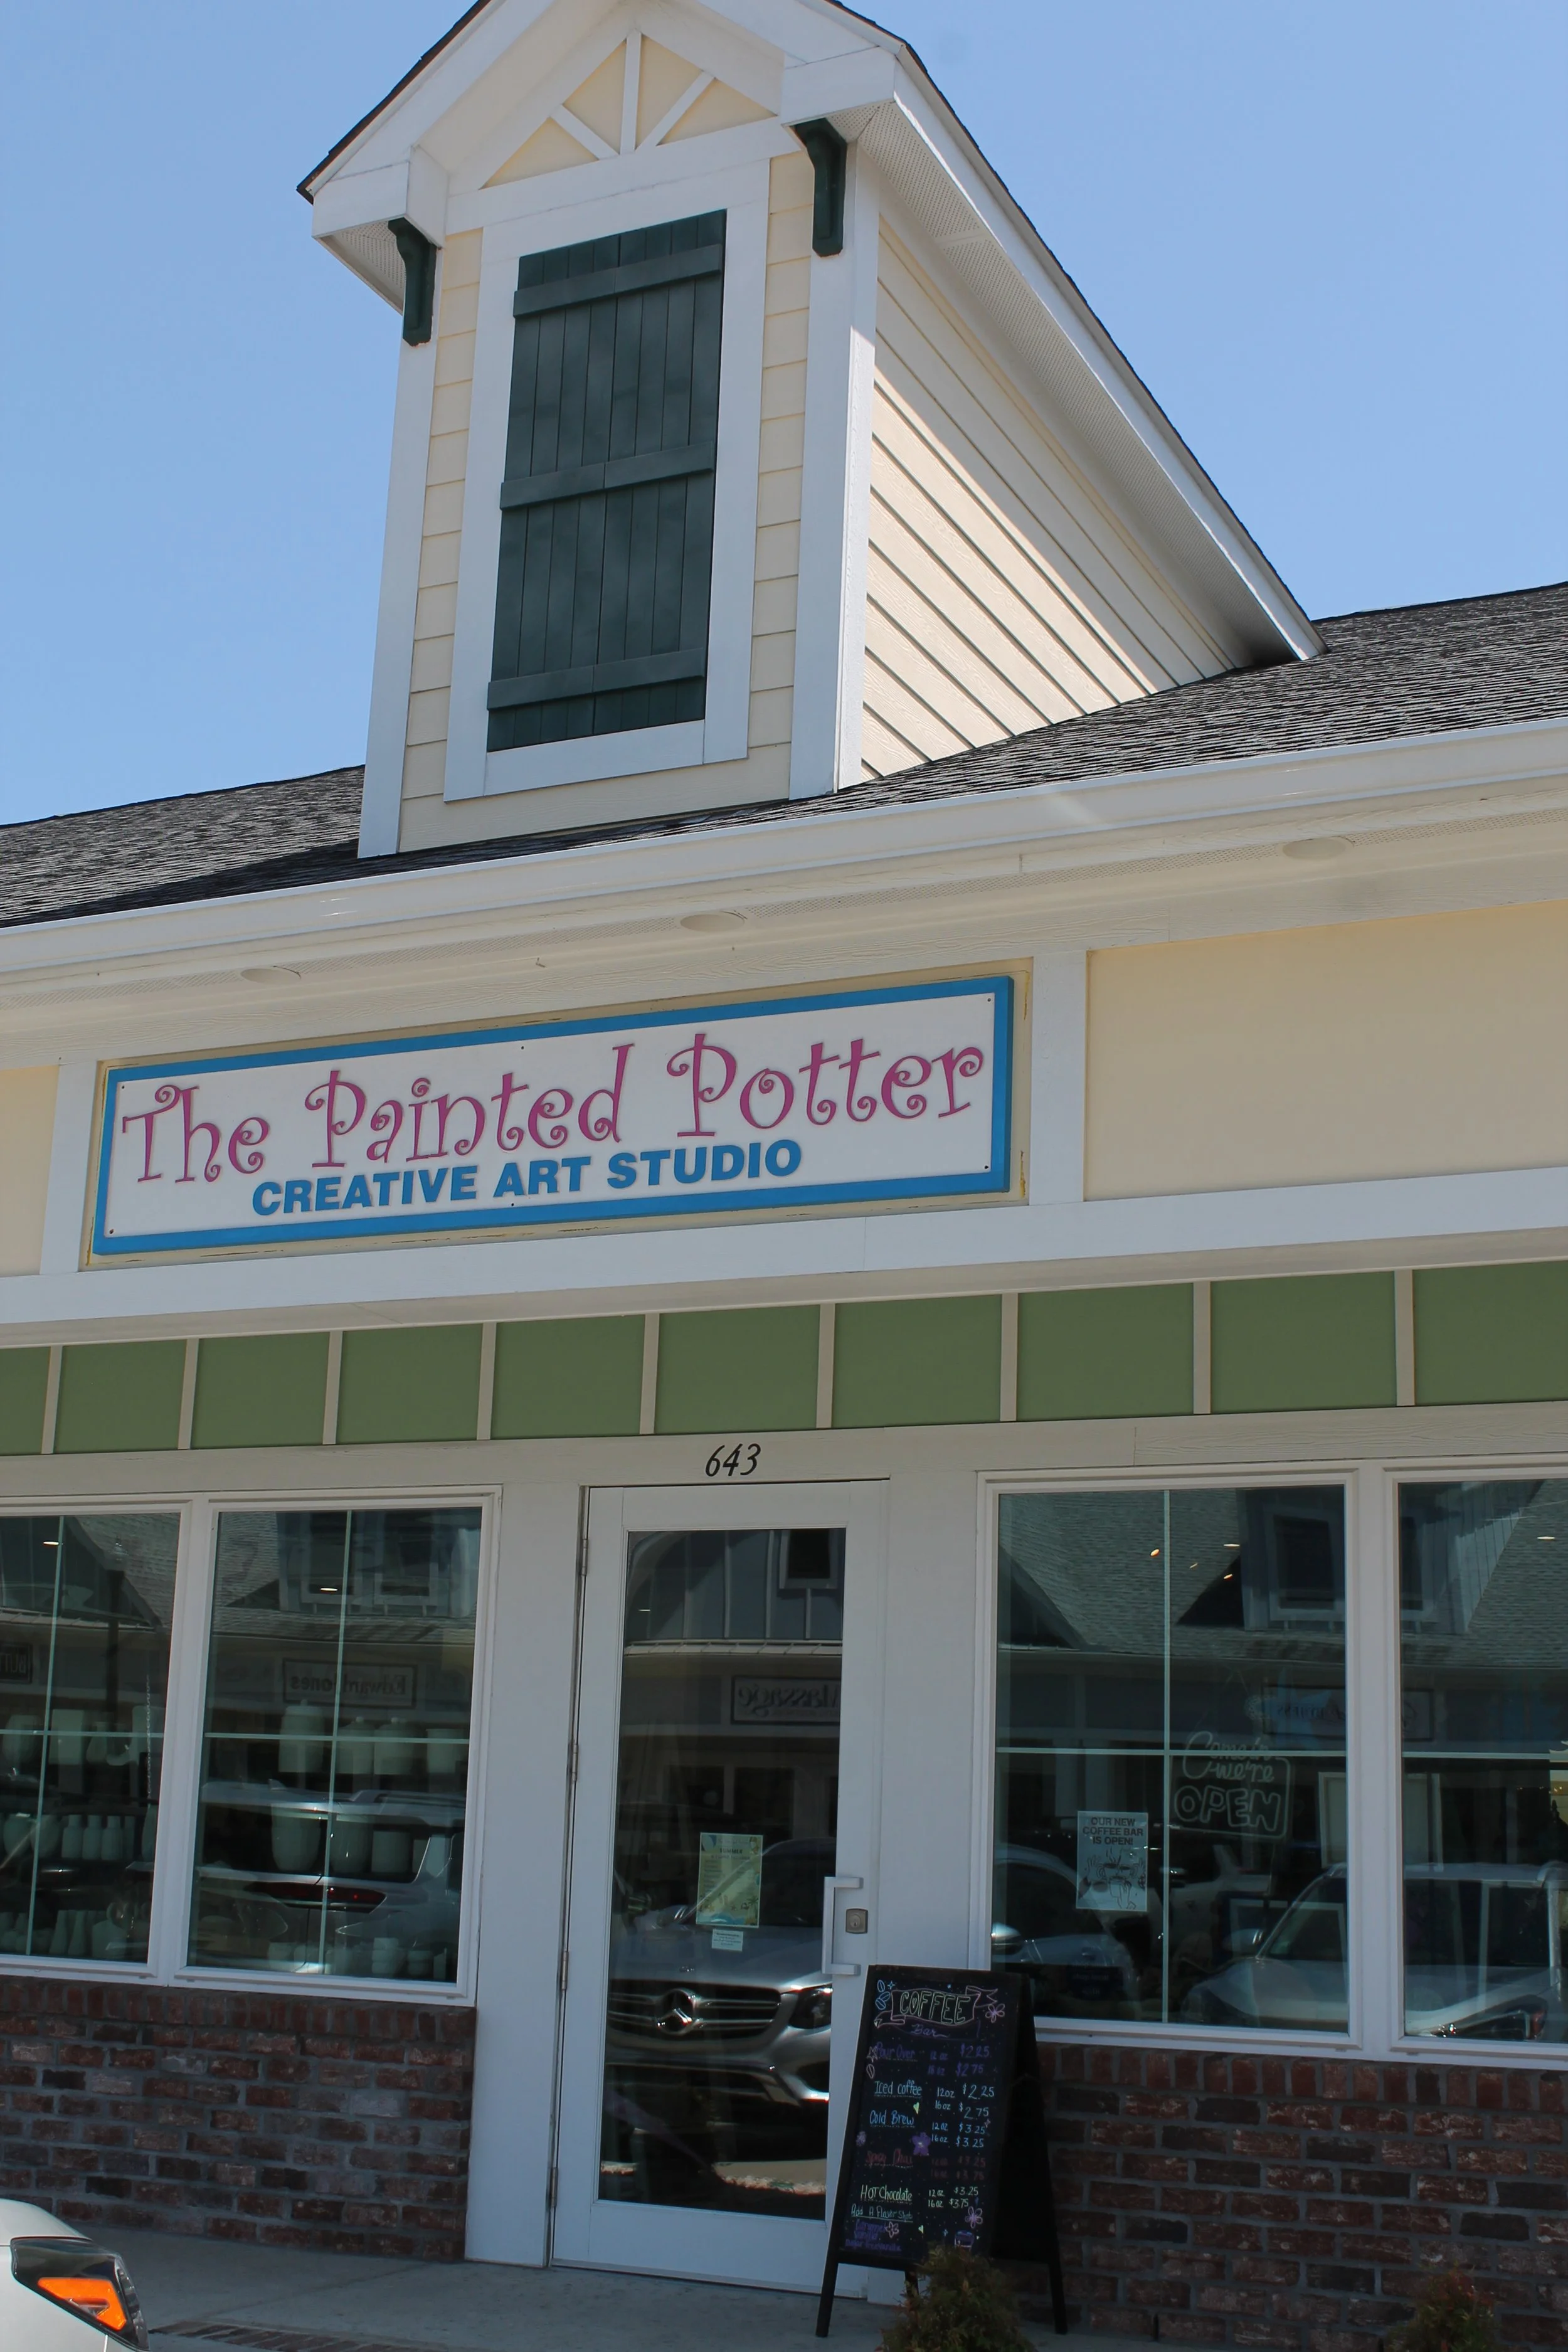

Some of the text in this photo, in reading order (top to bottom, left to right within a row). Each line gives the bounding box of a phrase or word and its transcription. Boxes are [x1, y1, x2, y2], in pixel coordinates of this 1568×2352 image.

[122, 1034, 984, 1184] The Painted Potter
[252, 1140, 801, 1216] CREATIVE ART STUDIO
[706, 1443, 761, 1477] 643
[1182, 1730, 1246, 1779] Come
[1213, 1760, 1274, 1782] we're
[1175, 1785, 1281, 1831] OPEN
[1091, 1817, 1135, 1826] OUR NEW
[1083, 1826, 1143, 1836] COFFEE BAR
[1104, 1837, 1133, 1845] OPEN!
[900, 1990, 971, 2025] COFFEE
[909, 2023, 950, 2038] Bar
[896, 2045, 916, 2059] Over
[874, 2080, 893, 2095] Iced
[898, 2079, 923, 2095] coffee
[869, 2110, 886, 2125] Cold
[891, 2110, 914, 2125] Brew
[861, 2184, 879, 2200] HOT
